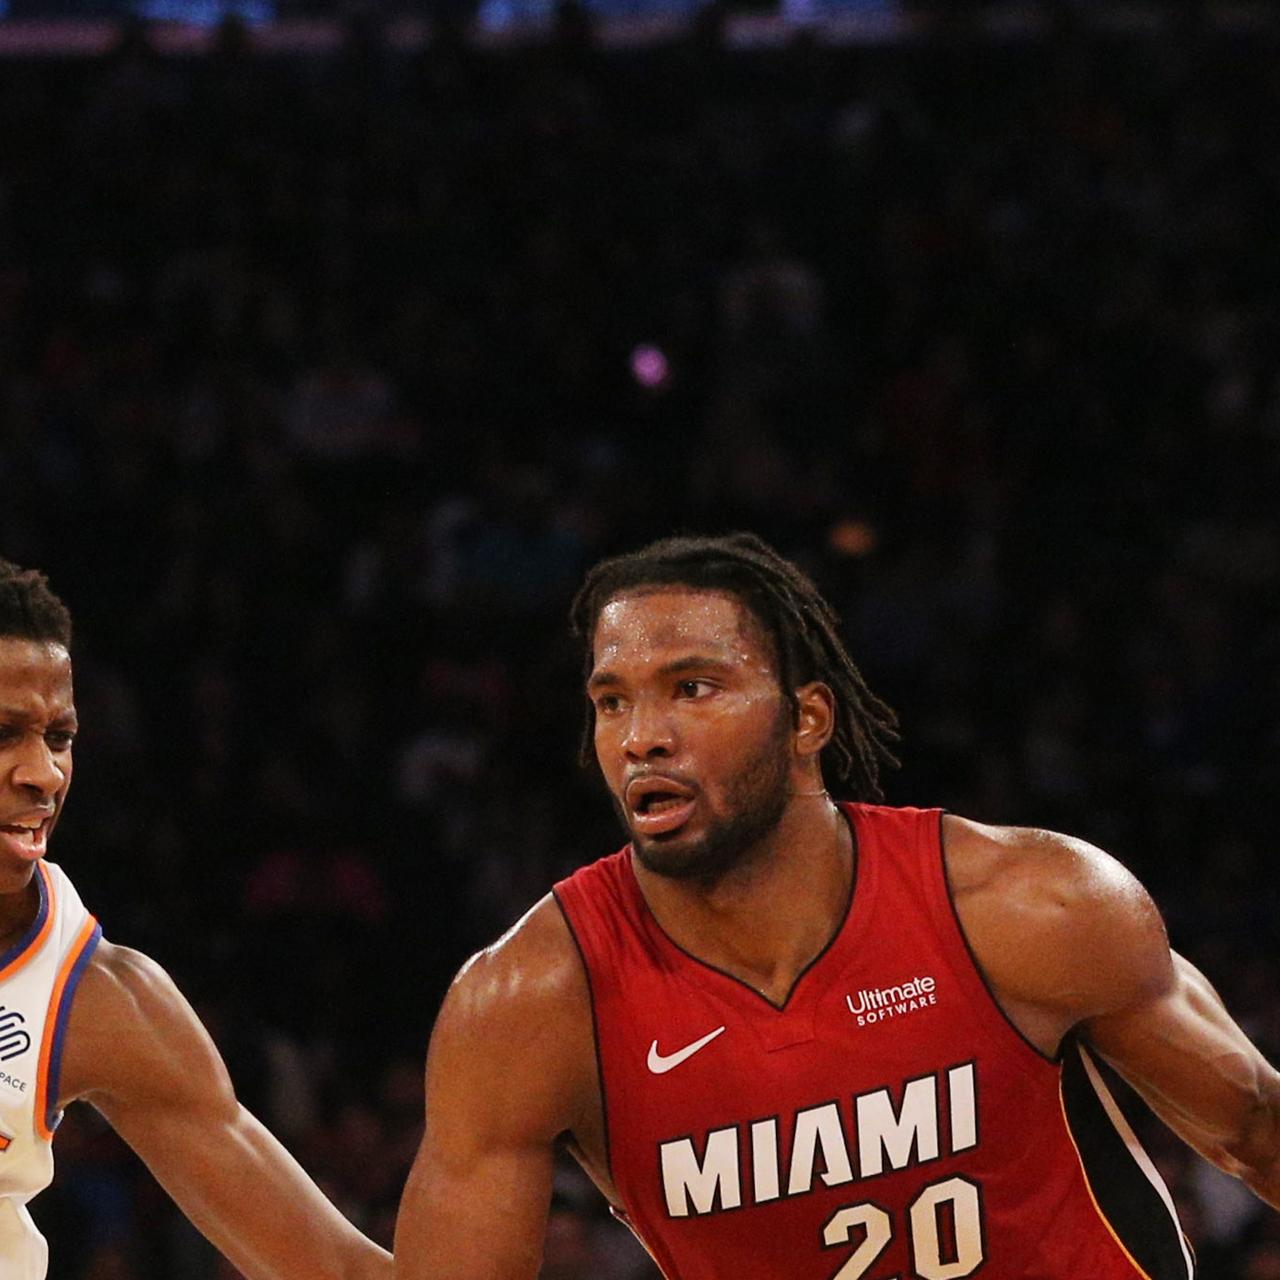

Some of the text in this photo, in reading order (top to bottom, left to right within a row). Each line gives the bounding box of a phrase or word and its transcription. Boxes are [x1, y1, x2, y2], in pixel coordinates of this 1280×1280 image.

[846, 977, 936, 1014] Ultimate
[857, 993, 937, 1026] SOFTWARE
[659, 1062, 978, 1218] MIAMI
